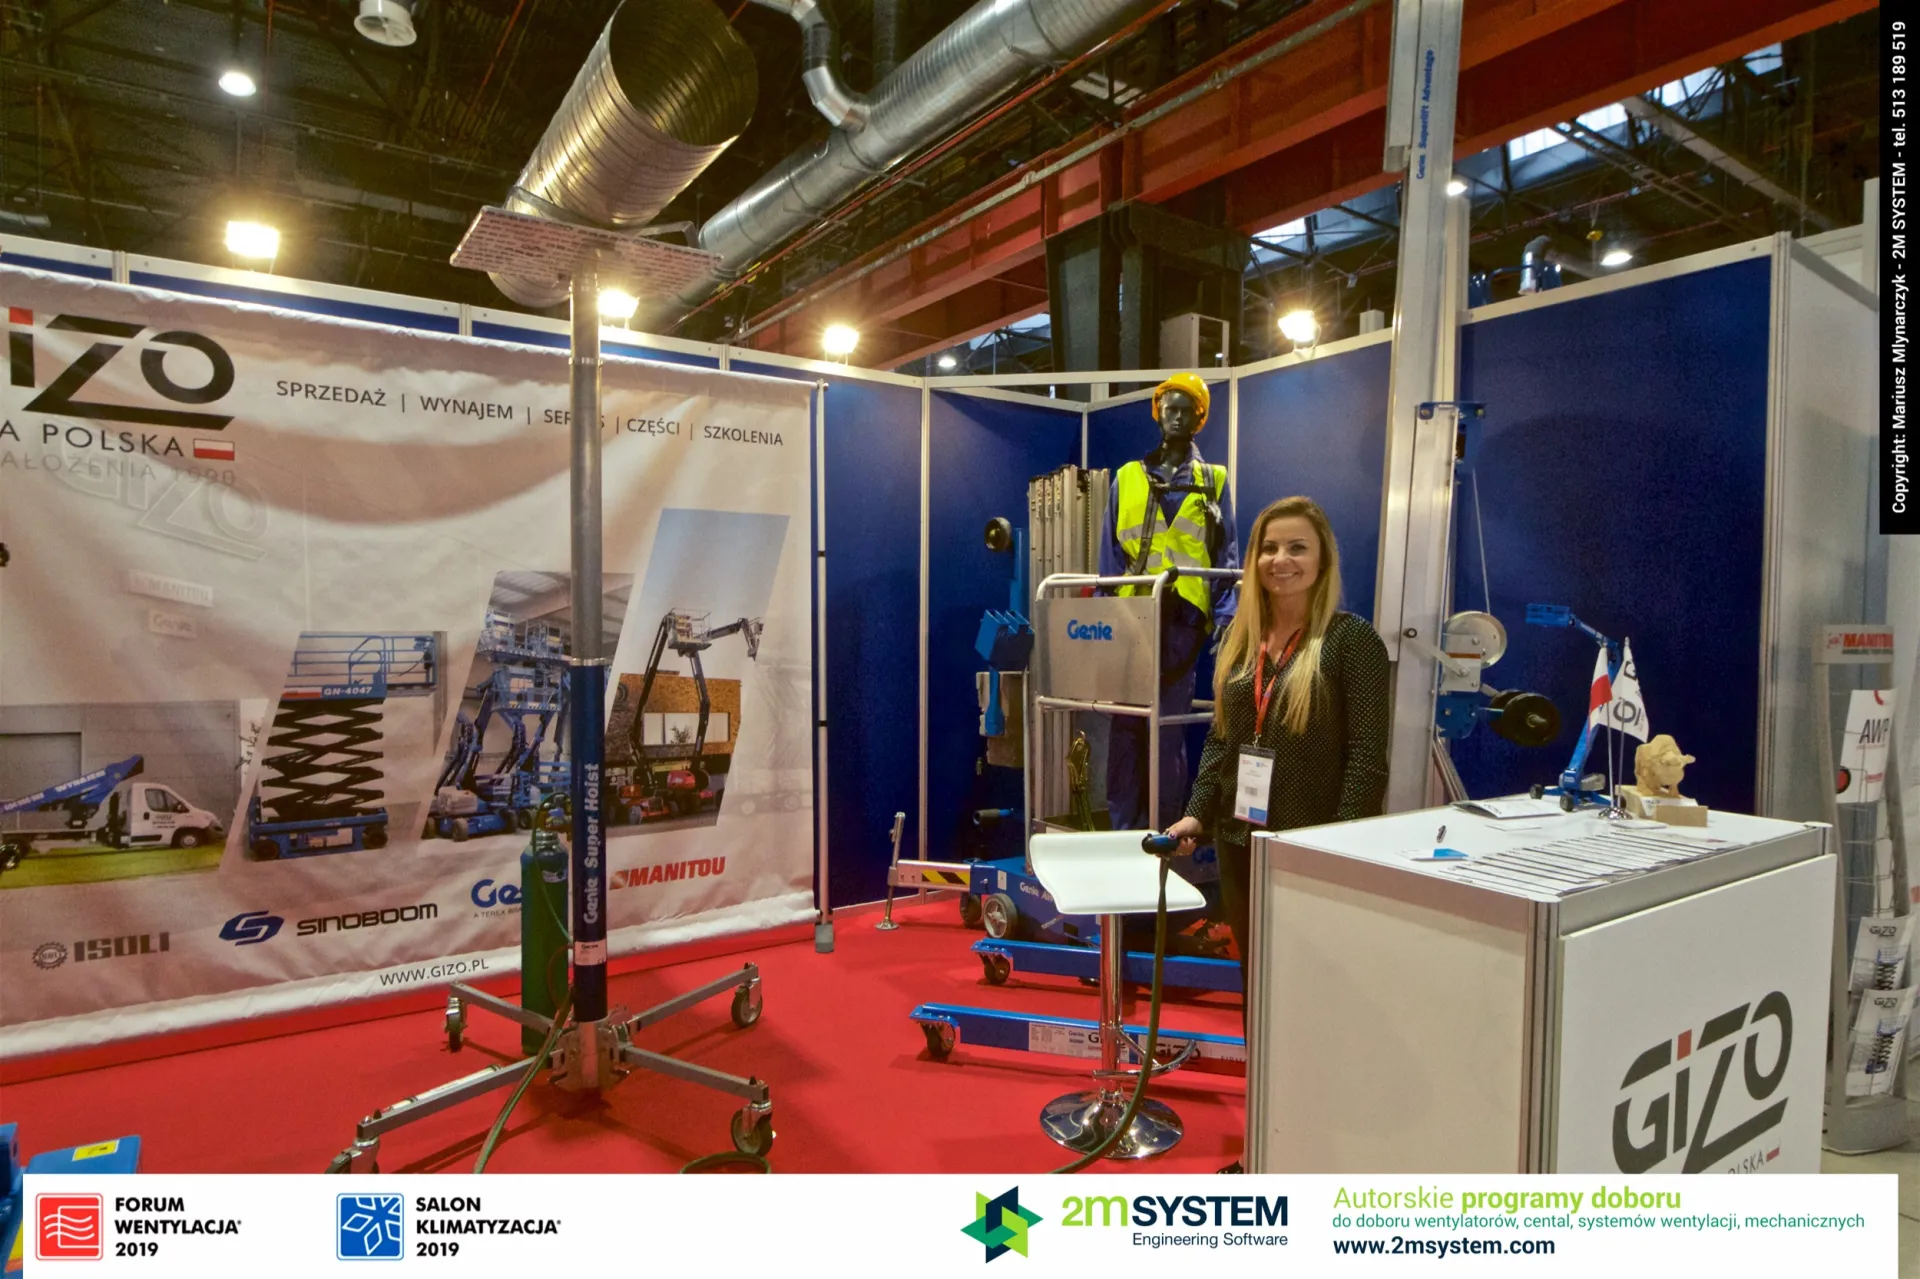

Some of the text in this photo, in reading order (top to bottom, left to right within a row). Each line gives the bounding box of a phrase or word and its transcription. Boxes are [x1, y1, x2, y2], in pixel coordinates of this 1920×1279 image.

[276, 380, 387, 407] SPRZEDAŻ
[419, 395, 514, 420] WYNAJEM
[627, 418, 680, 436] CZĘŚCI
[704, 425, 784, 447] SZKOLENIA
[42, 423, 185, 457] POLSKA
[1066, 619, 1113, 641] Genie
[323, 686, 373, 696] GN-4047
[584, 763, 600, 924] Genie Super Hoist
[628, 856, 726, 888] MANITOU
[74, 932, 169, 962] ISOLI
[379, 957, 489, 987] WWW.GIZO.PL
